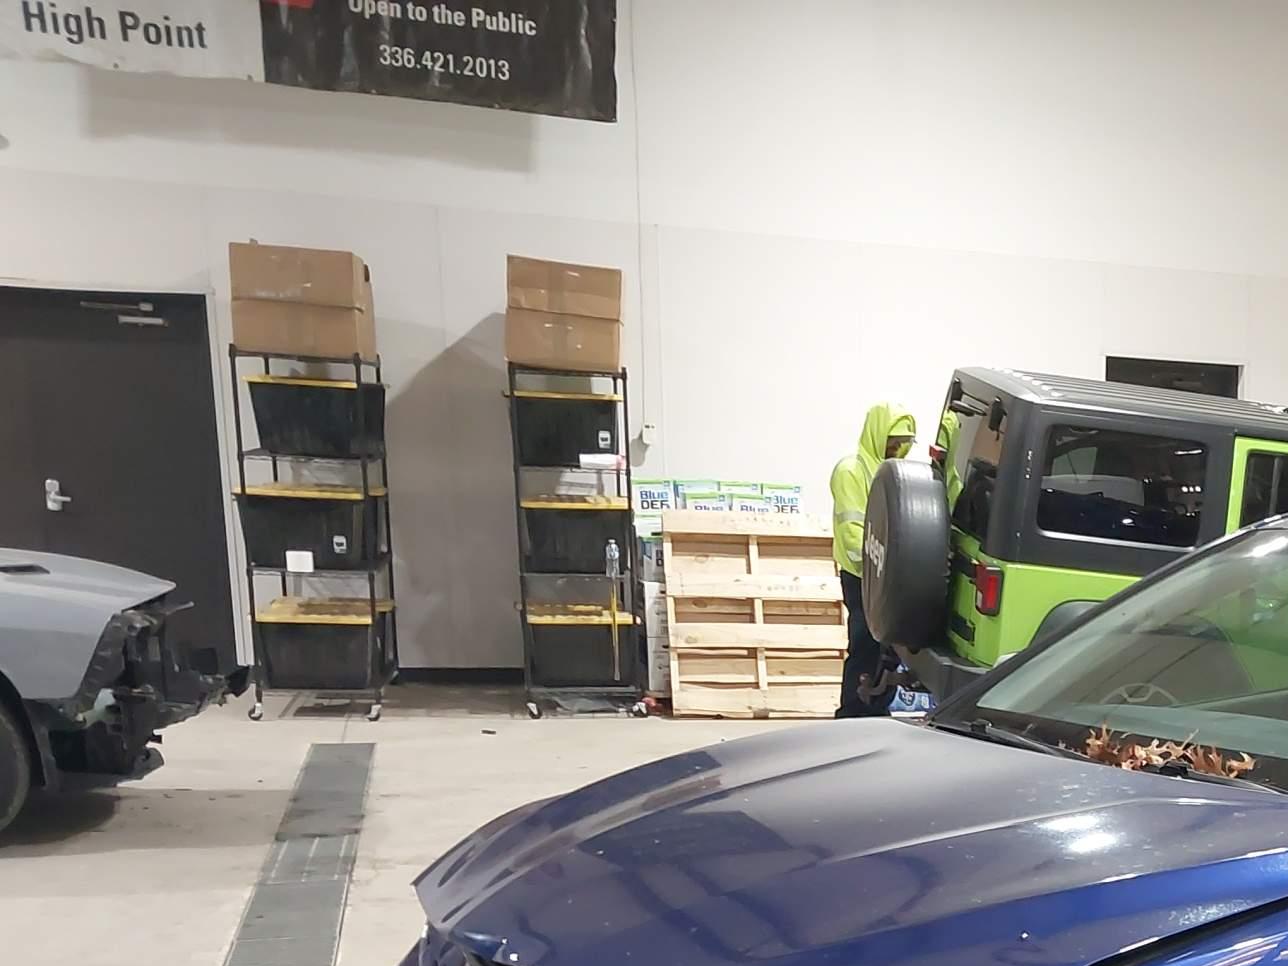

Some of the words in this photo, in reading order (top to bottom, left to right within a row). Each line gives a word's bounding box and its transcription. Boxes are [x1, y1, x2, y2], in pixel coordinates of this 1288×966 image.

[22, 1, 107, 45] High
[118, 10, 208, 49] Point
[348, 0, 402, 19] Open
[406, 2, 428, 22] to
[432, 4, 466, 27] the
[471, 7, 537, 37] Public
[379, 44, 510, 81] 336.421.2013
[640, 490, 669, 500] Blue
[865, 521, 885, 578] Jeep
